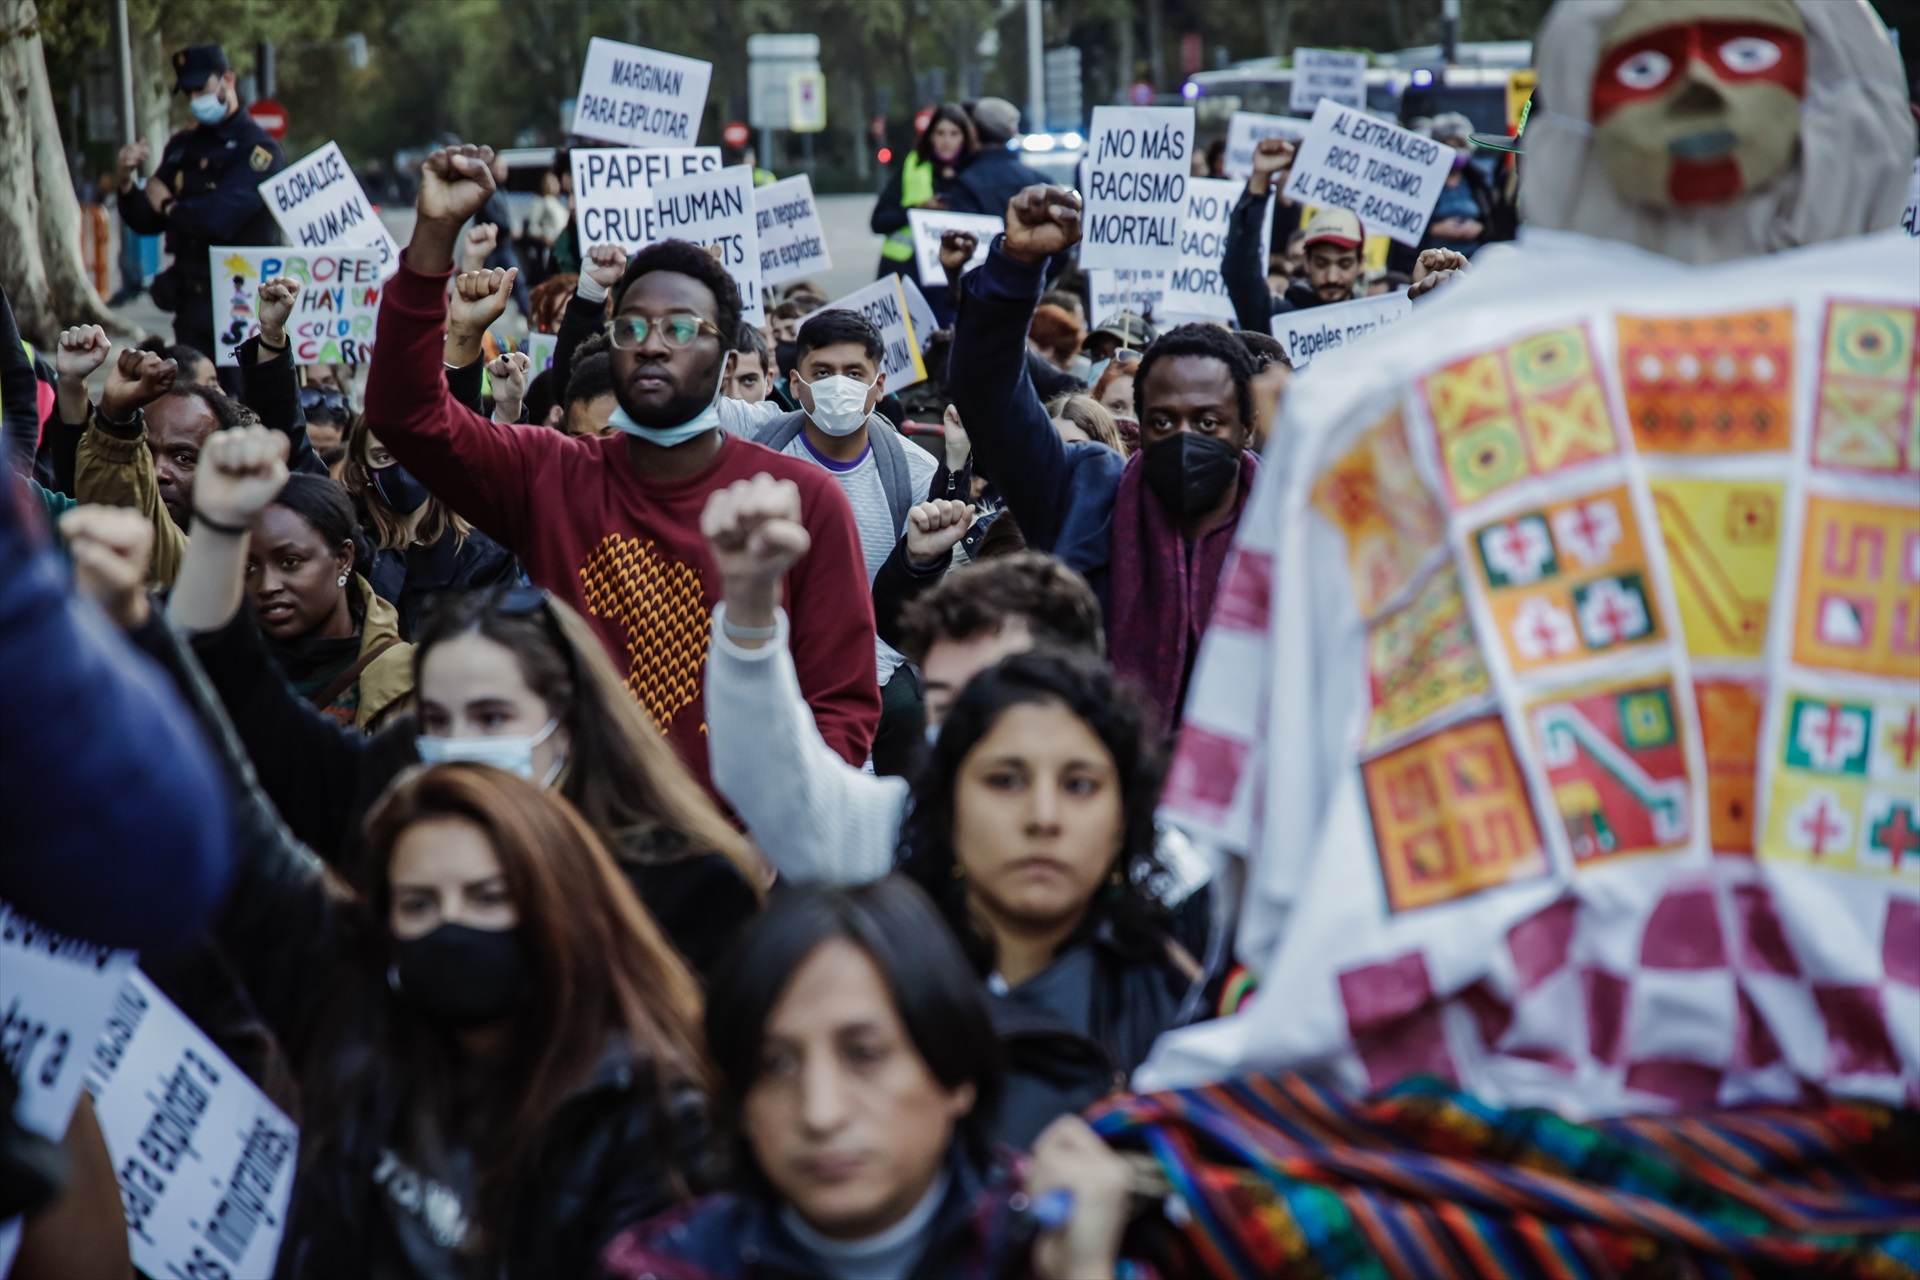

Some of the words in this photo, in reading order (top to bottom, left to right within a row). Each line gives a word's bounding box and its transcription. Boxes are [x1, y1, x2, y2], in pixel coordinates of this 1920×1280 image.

[611, 59, 683, 97] MARGINAN
[581, 93, 617, 125] PARA
[618, 101, 689, 139] EXPLOTAR.
[1097, 129, 1135, 165] ¡NO
[1141, 123, 1184, 160] MÁS
[1330, 112, 1350, 136] AL
[1351, 118, 1439, 167] EXTRANJERO
[274, 152, 345, 212] GLOBALICE
[1090, 171, 1185, 203] RACISMO
[1324, 146, 1361, 179] RICO,
[1363, 158, 1422, 199] TURISMO.
[299, 196, 365, 248] HUMAN
[658, 186, 743, 228] HUMAN
[1188, 196, 1217, 221] NO
[1292, 172, 1312, 195] AL
[1361, 195, 1423, 236] RACISMO.
[1089, 214, 1176, 246] MORTAL!
[261, 257, 378, 285] PROFE:
[302, 287, 345, 314] HAY
[352, 287, 379, 307] UN
[298, 315, 372, 339] COLOR
[1289, 324, 1342, 359] Papeles
